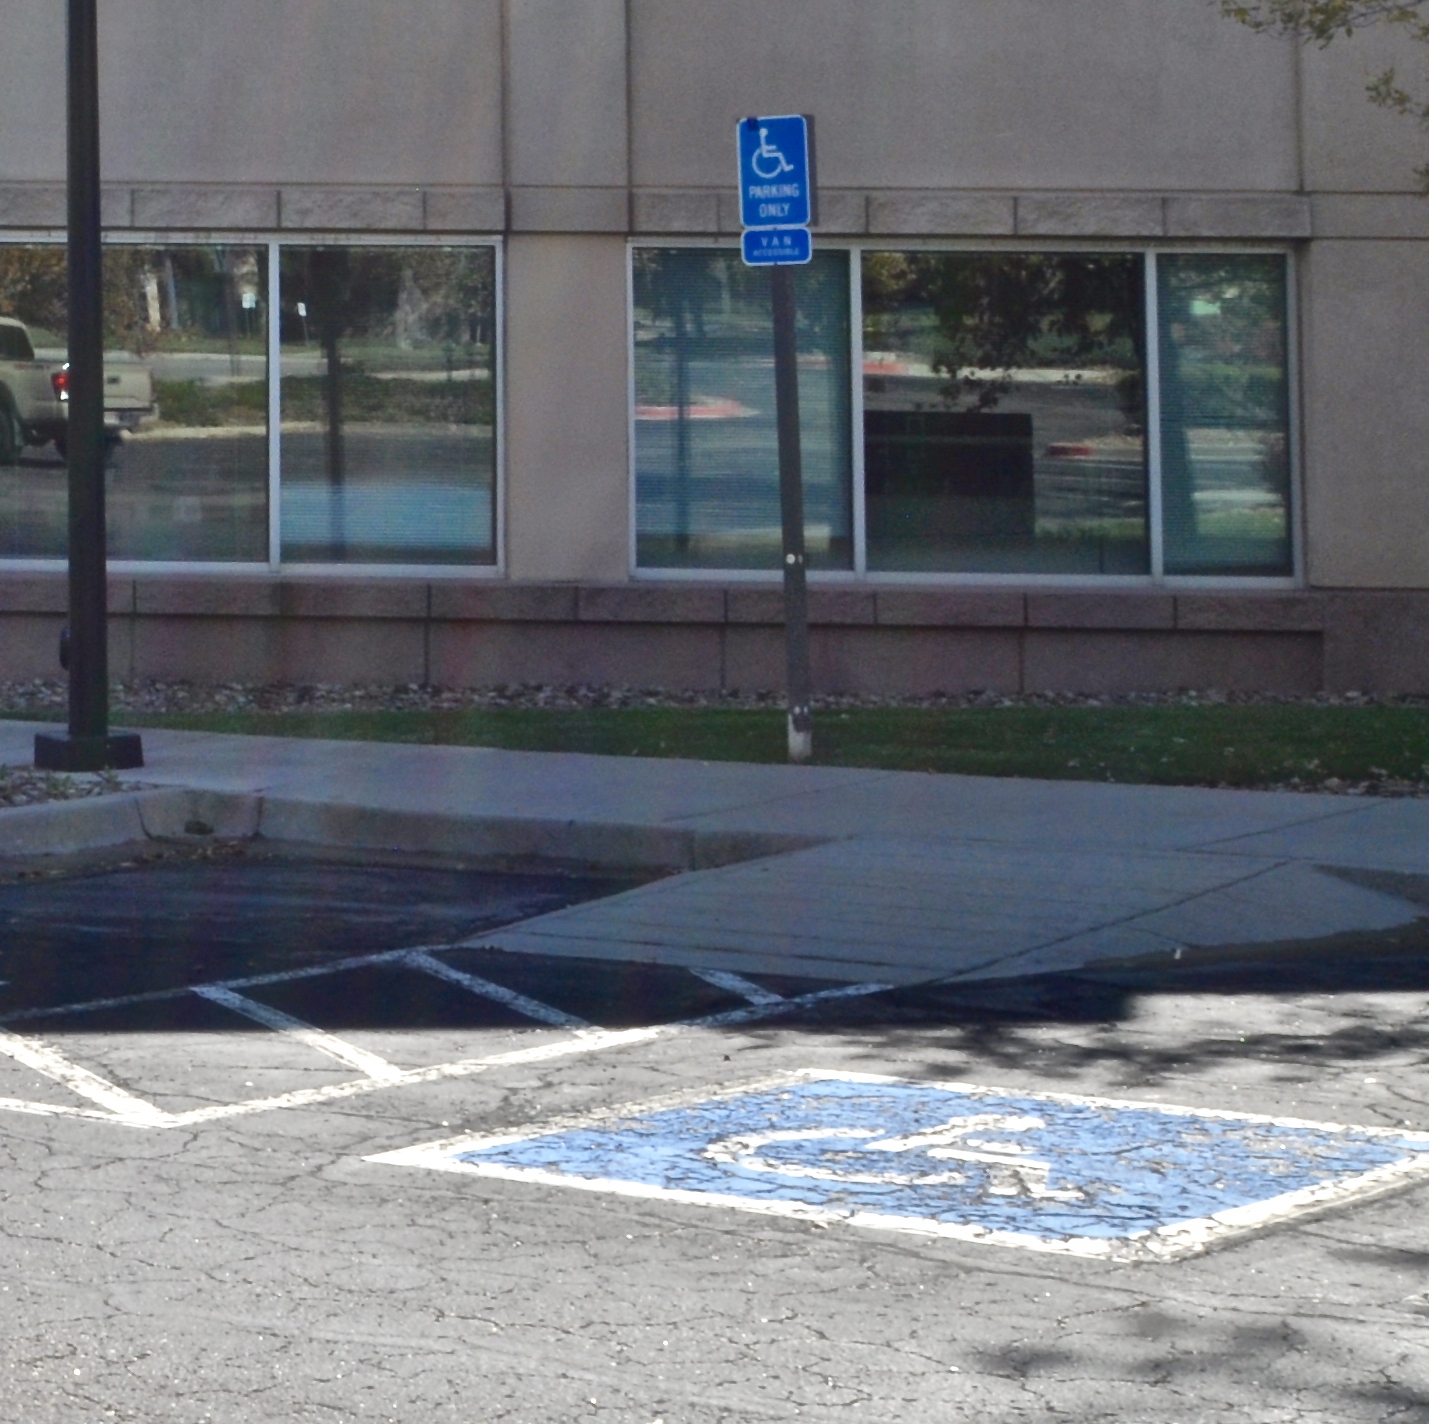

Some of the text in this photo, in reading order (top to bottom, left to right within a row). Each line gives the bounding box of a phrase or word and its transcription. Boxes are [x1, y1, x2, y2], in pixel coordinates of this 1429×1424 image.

[749, 183, 800, 199] PARKING
[759, 204, 790, 218] ONLY
[761, 236, 792, 247] VAN
